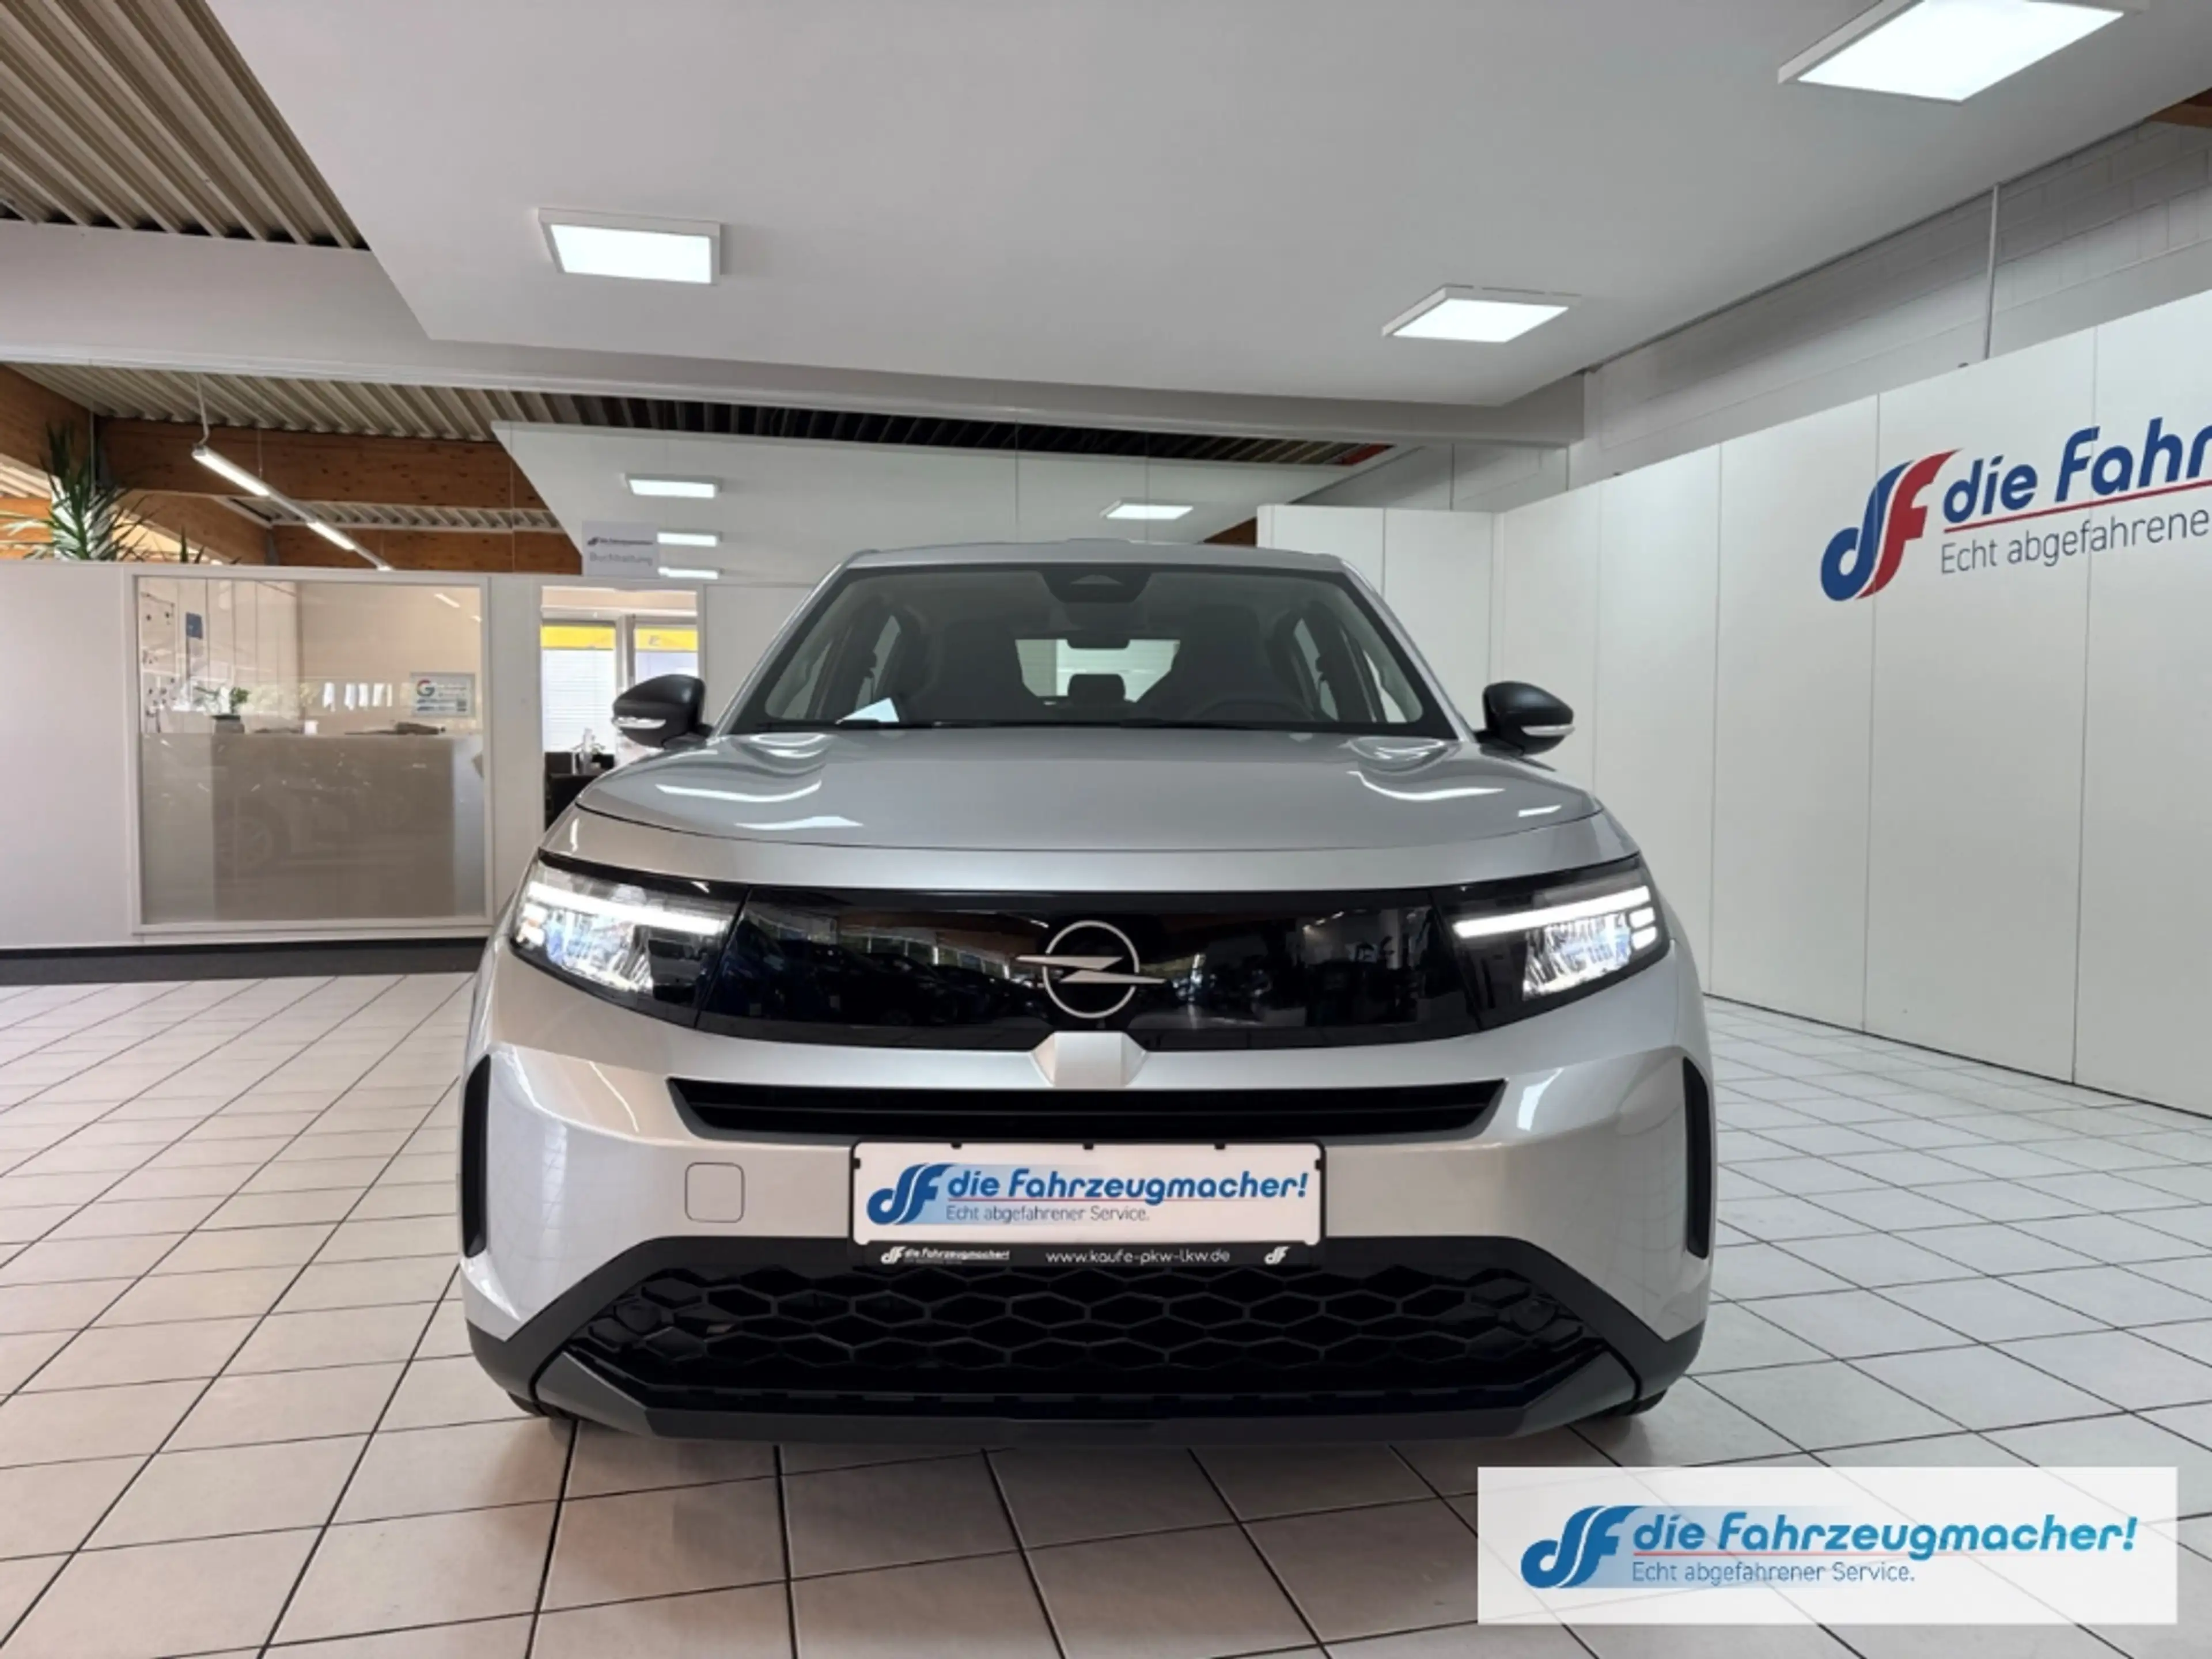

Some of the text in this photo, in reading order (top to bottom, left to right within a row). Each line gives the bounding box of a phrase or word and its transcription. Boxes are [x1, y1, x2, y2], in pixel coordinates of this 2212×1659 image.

[1943, 455, 2037, 523] die
[1941, 509, 2210, 575] Echt abgefahrene
[948, 1168, 1309, 1206] die Fahrzeugmacher!
[946, 1205, 1150, 1224] Echt abgefahrener Service.
[1046, 1248, 1230, 1266] www.kaufe-pkw-lkw.de
